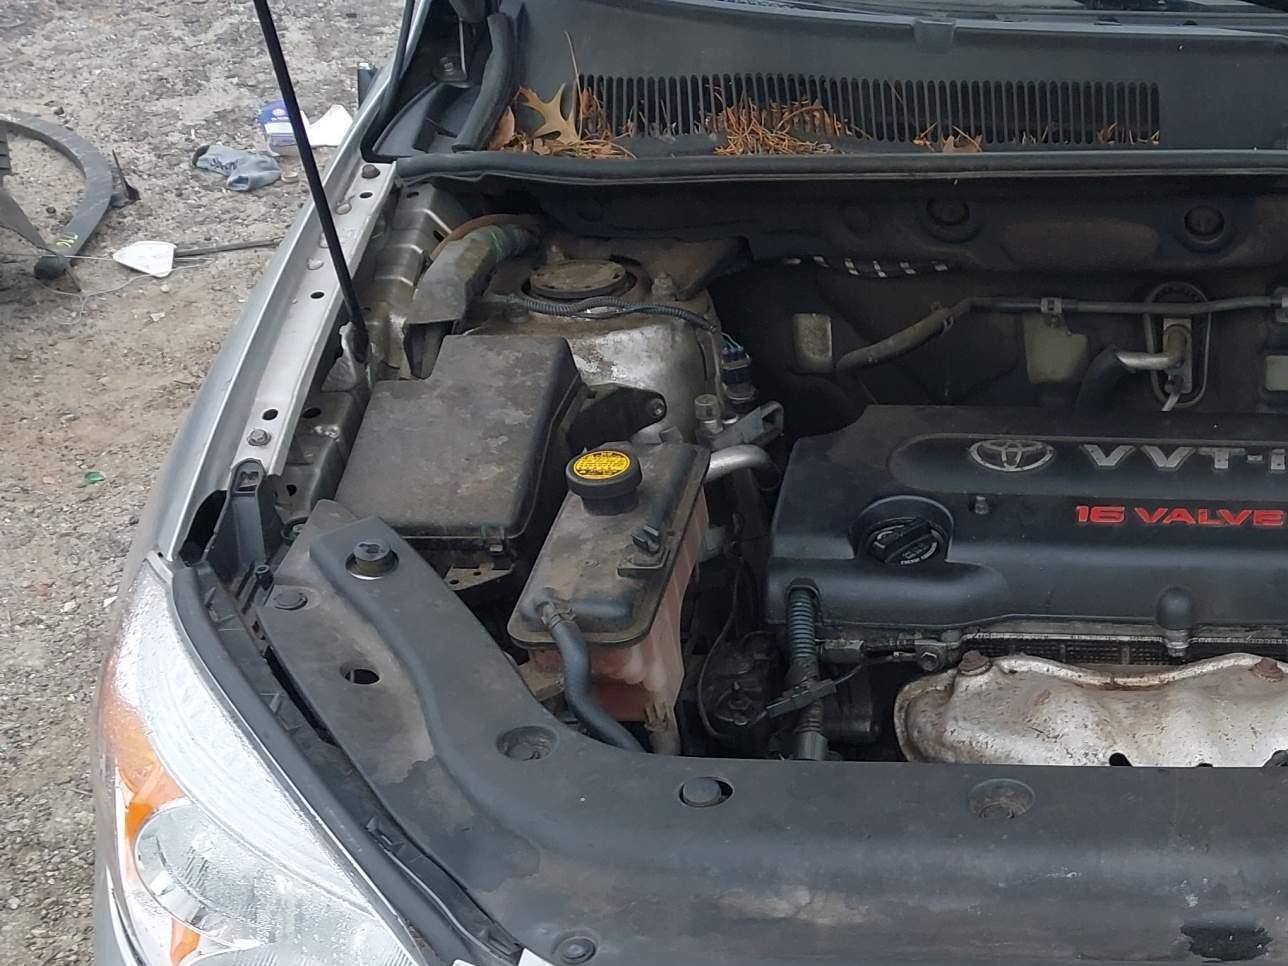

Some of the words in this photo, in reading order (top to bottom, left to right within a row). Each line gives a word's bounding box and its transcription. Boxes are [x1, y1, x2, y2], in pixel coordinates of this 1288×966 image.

[1082, 444, 1287, 472] VVT-i
[1076, 505, 1125, 524] 16
[1135, 507, 1284, 527] VALVE
